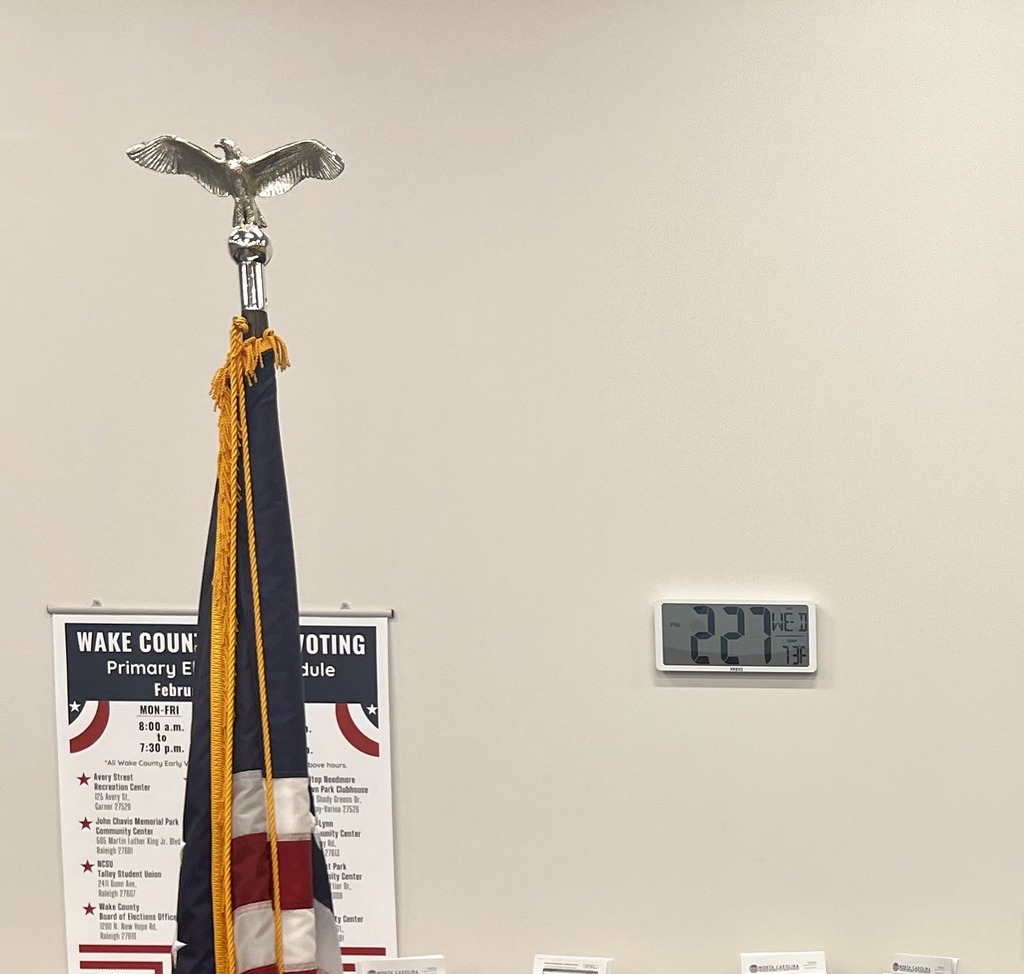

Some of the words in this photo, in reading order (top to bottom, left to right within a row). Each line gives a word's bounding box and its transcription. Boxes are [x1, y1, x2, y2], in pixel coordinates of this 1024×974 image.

[772, 612, 807, 632] WED
[77, 631, 132, 652] WAKE
[140, 632, 197, 653] COUN
[107, 660, 176, 679] Primary
[302, 662, 336, 677] dule
[154, 682, 192, 697] Febru
[140, 705, 179, 715] MON-FRI
[139, 721, 160, 731] 8:00
[157, 733, 167, 742] to
[140, 743, 160, 753] 7:30
[164, 746, 184, 754] p.m.
[138, 760, 163, 768] County
[164, 760, 182, 768] Early
[94, 773, 111, 781] Avery
[113, 773, 133, 781] Street
[94, 783, 128, 791] Recreation
[130, 783, 150, 791] Center
[336, 786, 368, 794] Clubhouse
[95, 817, 111, 825] John
[112, 817, 133, 825] Chavis
[96, 827, 131, 836] Community
[133, 827, 153, 835] Center
[340, 830, 361, 838] Center
[97, 860, 113, 868] NCSU
[98, 870, 116, 879] Talley
[117, 870, 142, 878] Student
[118, 903, 139, 912] County
[158, 913, 177, 921] Office
[343, 915, 364, 923] Center
